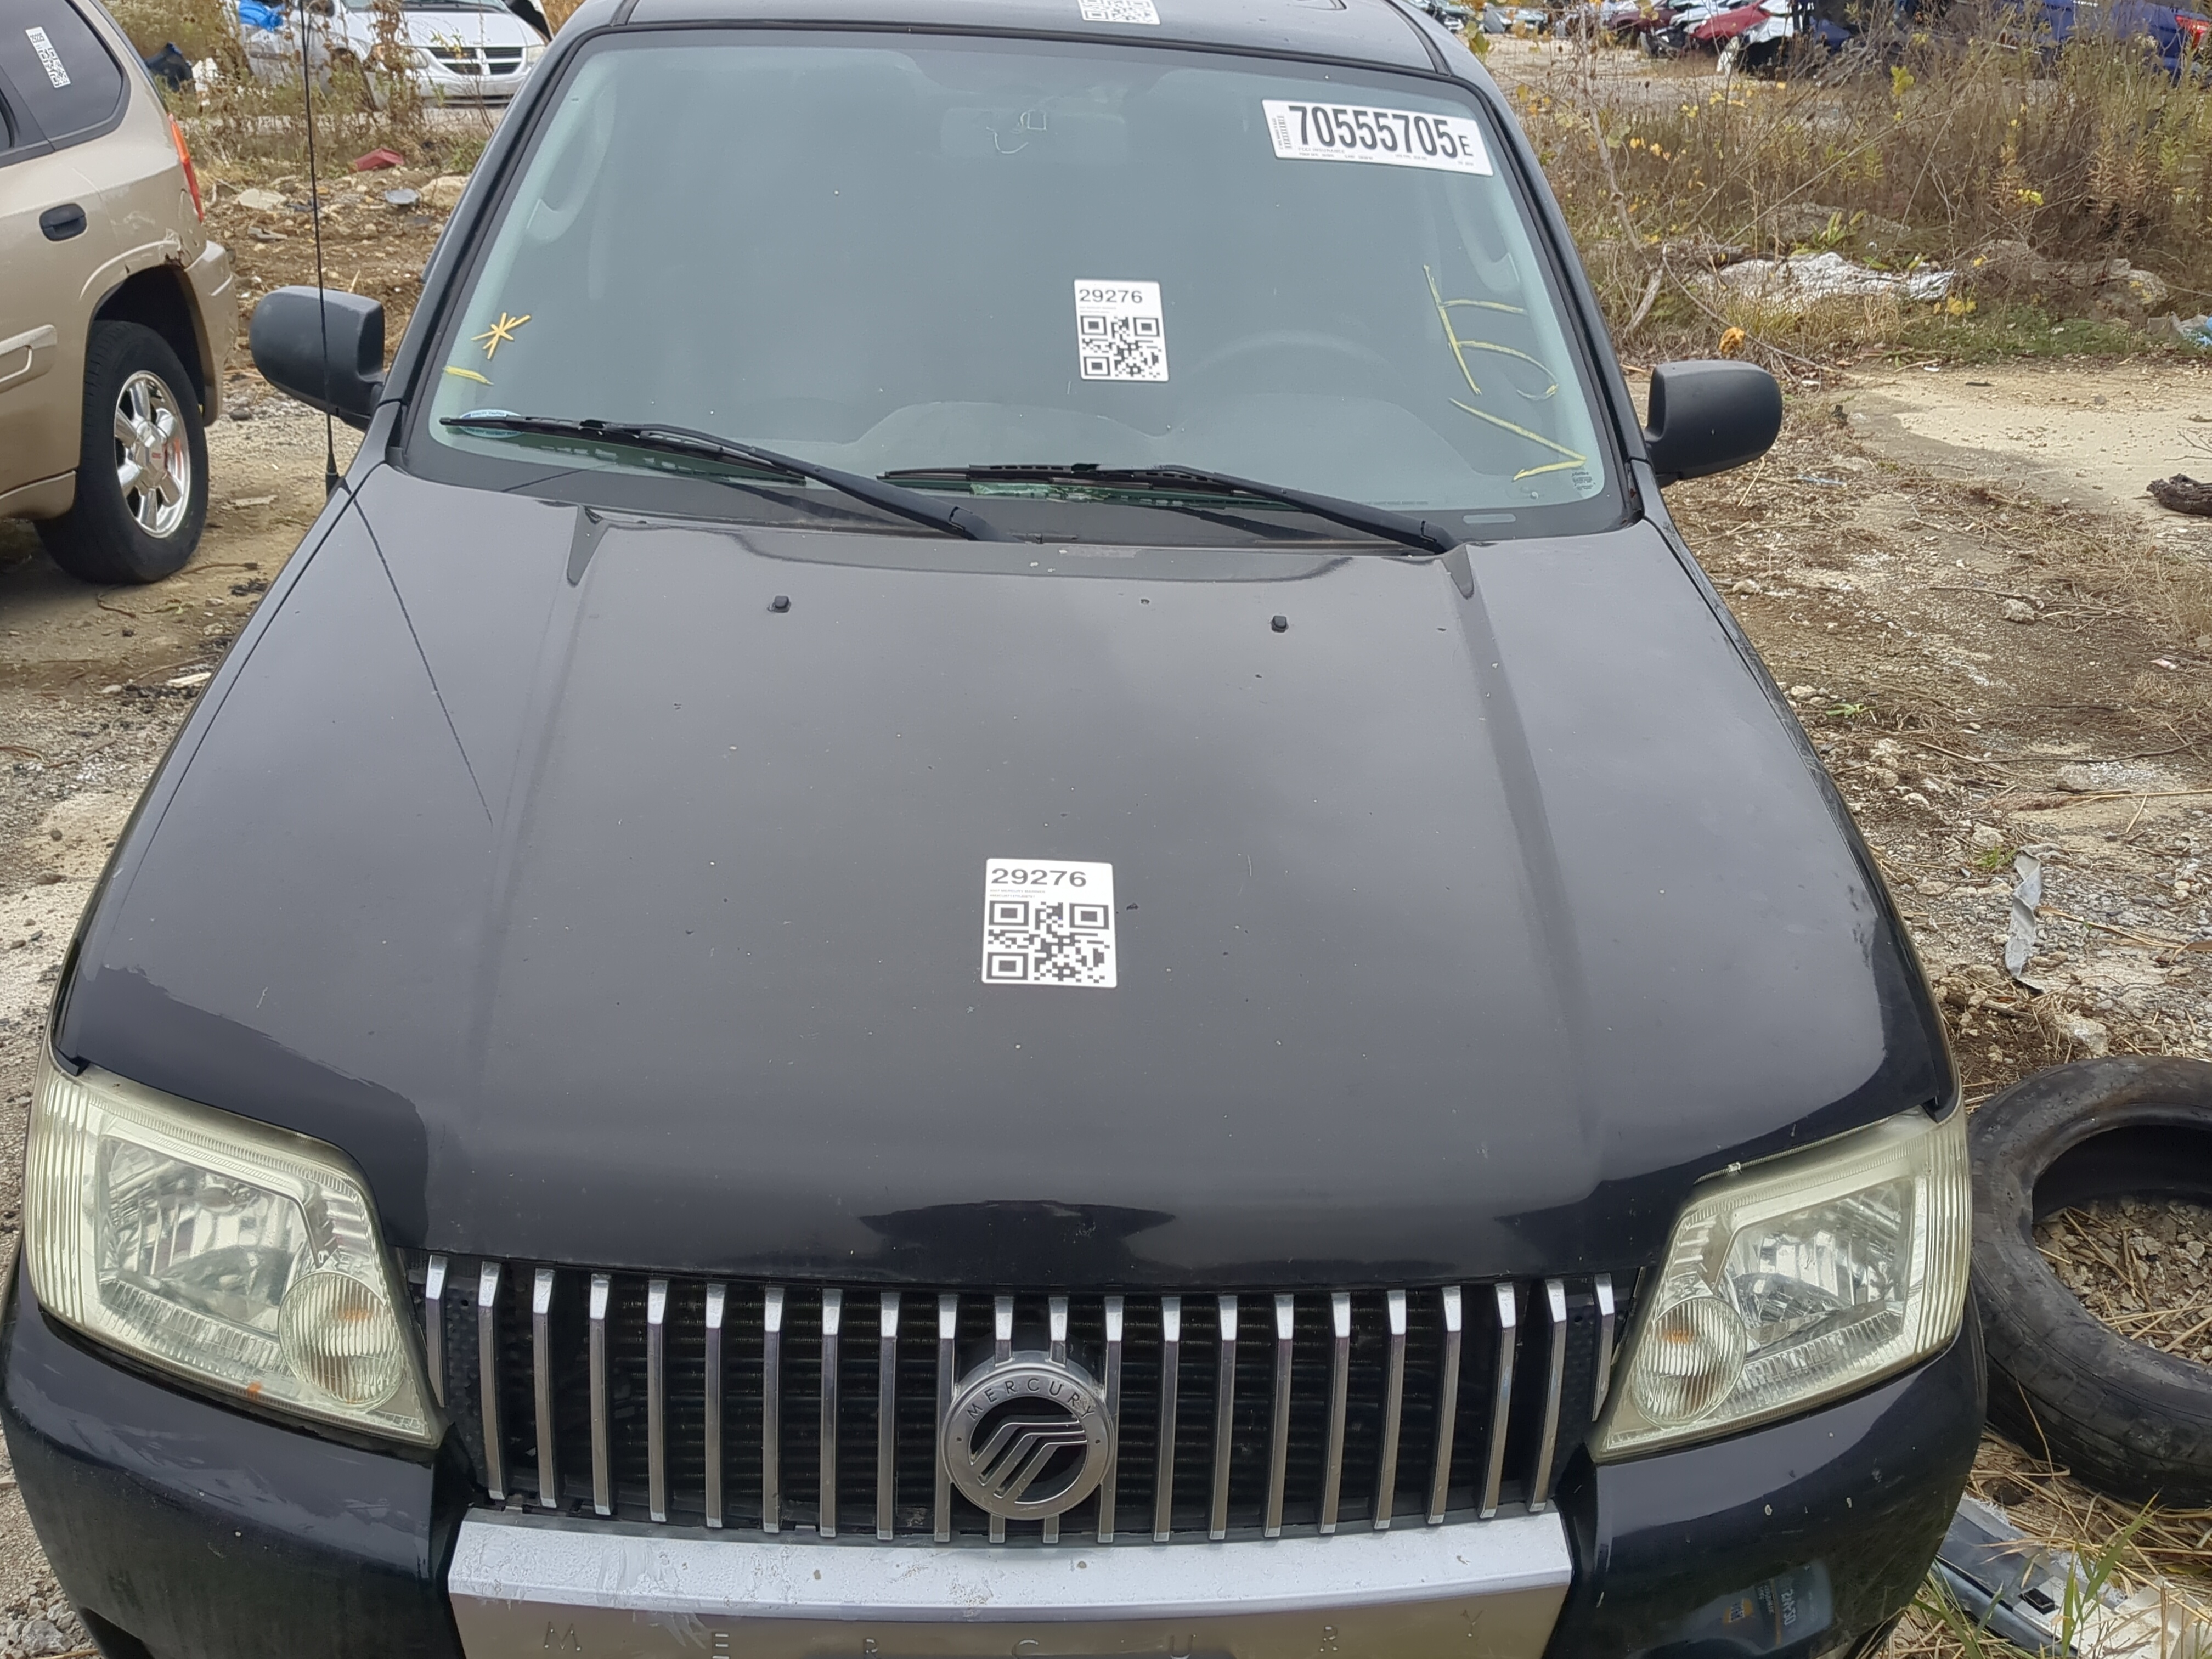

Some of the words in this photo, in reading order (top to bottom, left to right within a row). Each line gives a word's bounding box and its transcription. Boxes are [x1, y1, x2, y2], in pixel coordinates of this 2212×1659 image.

[1079, 289, 1143, 303] 29276
[991, 868, 1087, 887] 29276
[966, 1378, 1096, 1420] MERCURY
